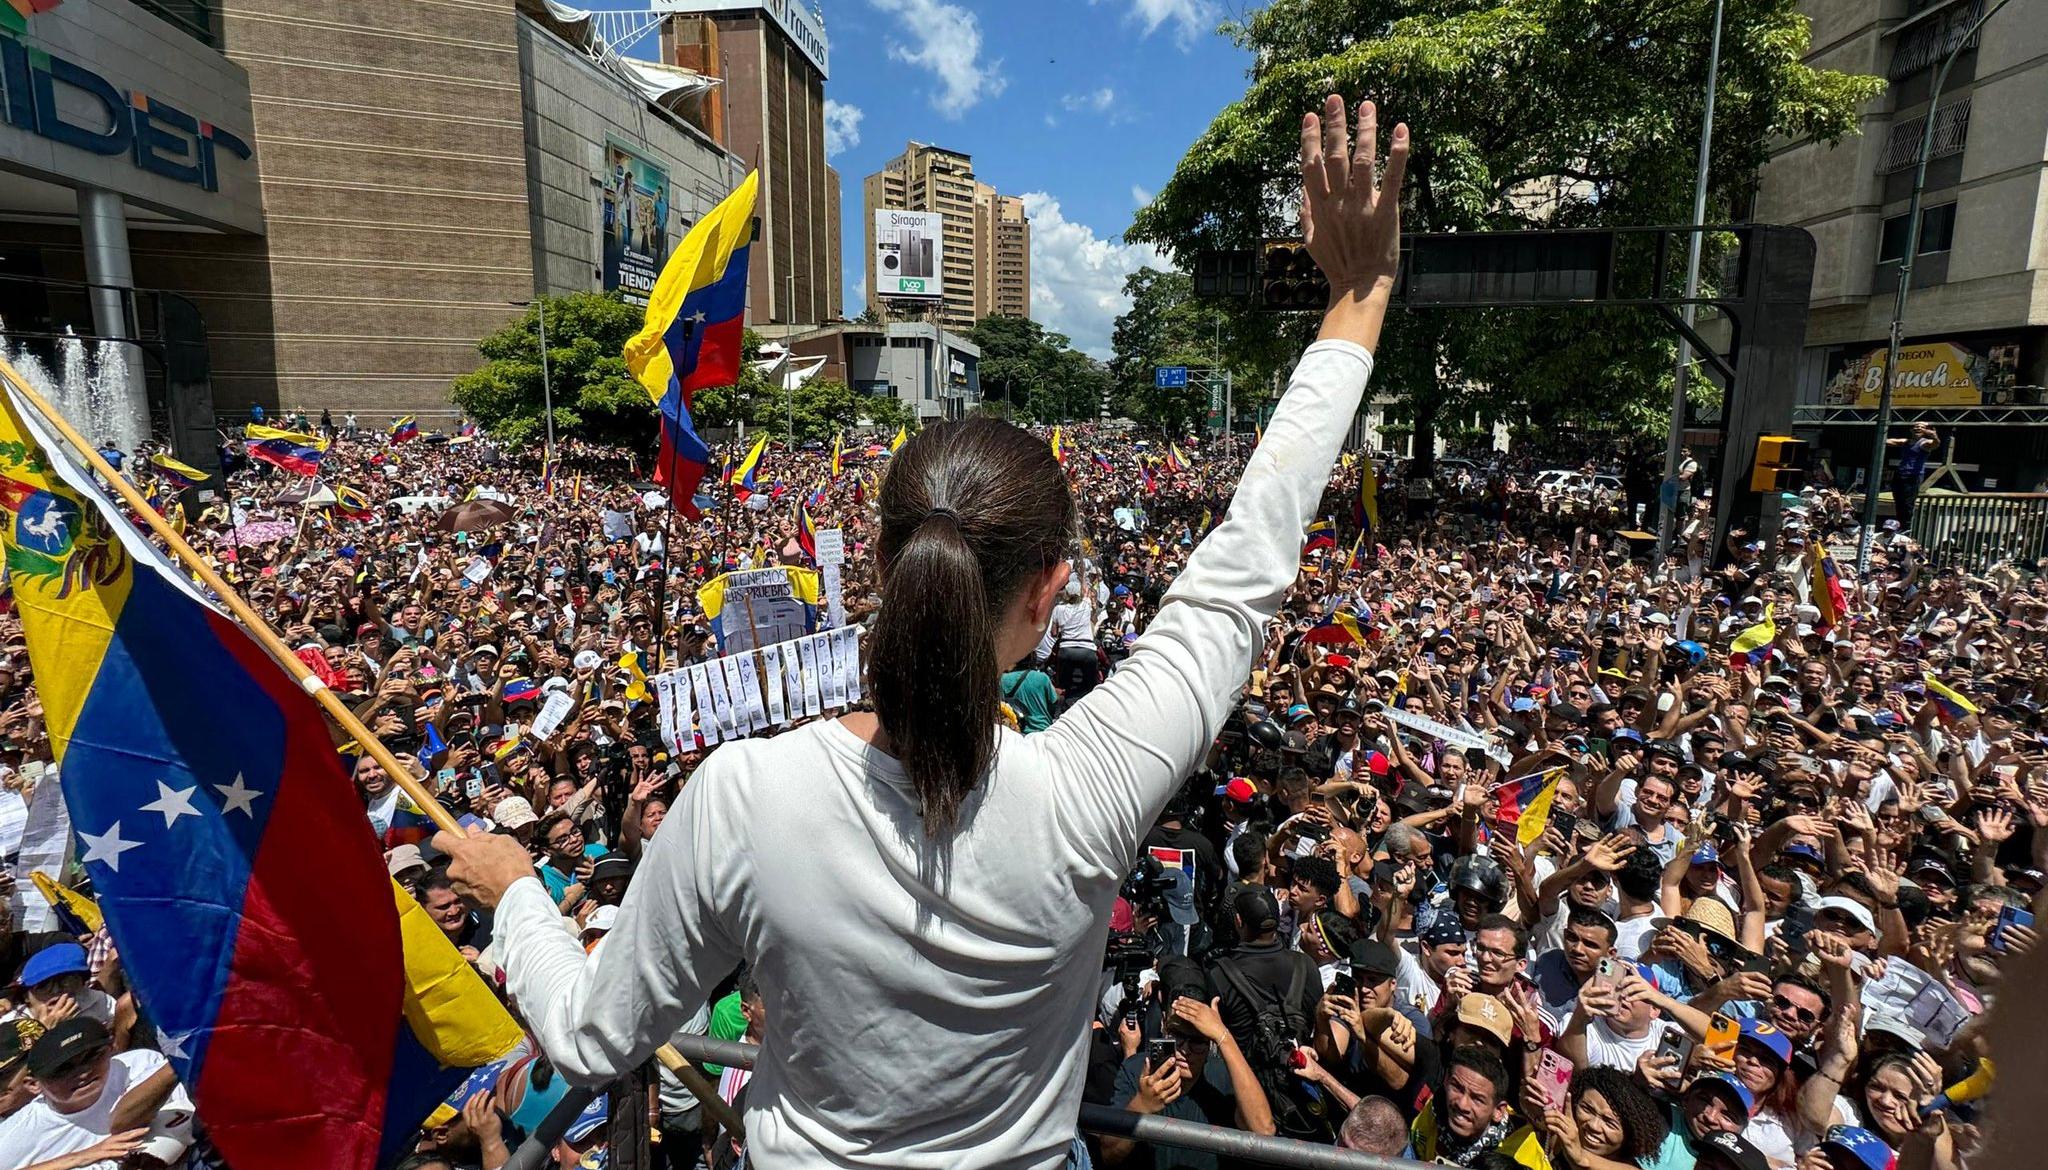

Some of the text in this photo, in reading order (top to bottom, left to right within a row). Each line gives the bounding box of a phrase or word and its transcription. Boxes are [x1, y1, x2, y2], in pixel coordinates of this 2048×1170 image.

[618, 270, 656, 291] TIENDA
[1883, 350, 1935, 362] DEGON
[1863, 362, 1949, 393] Bruch
[746, 583, 790, 600] PRUEBAS
